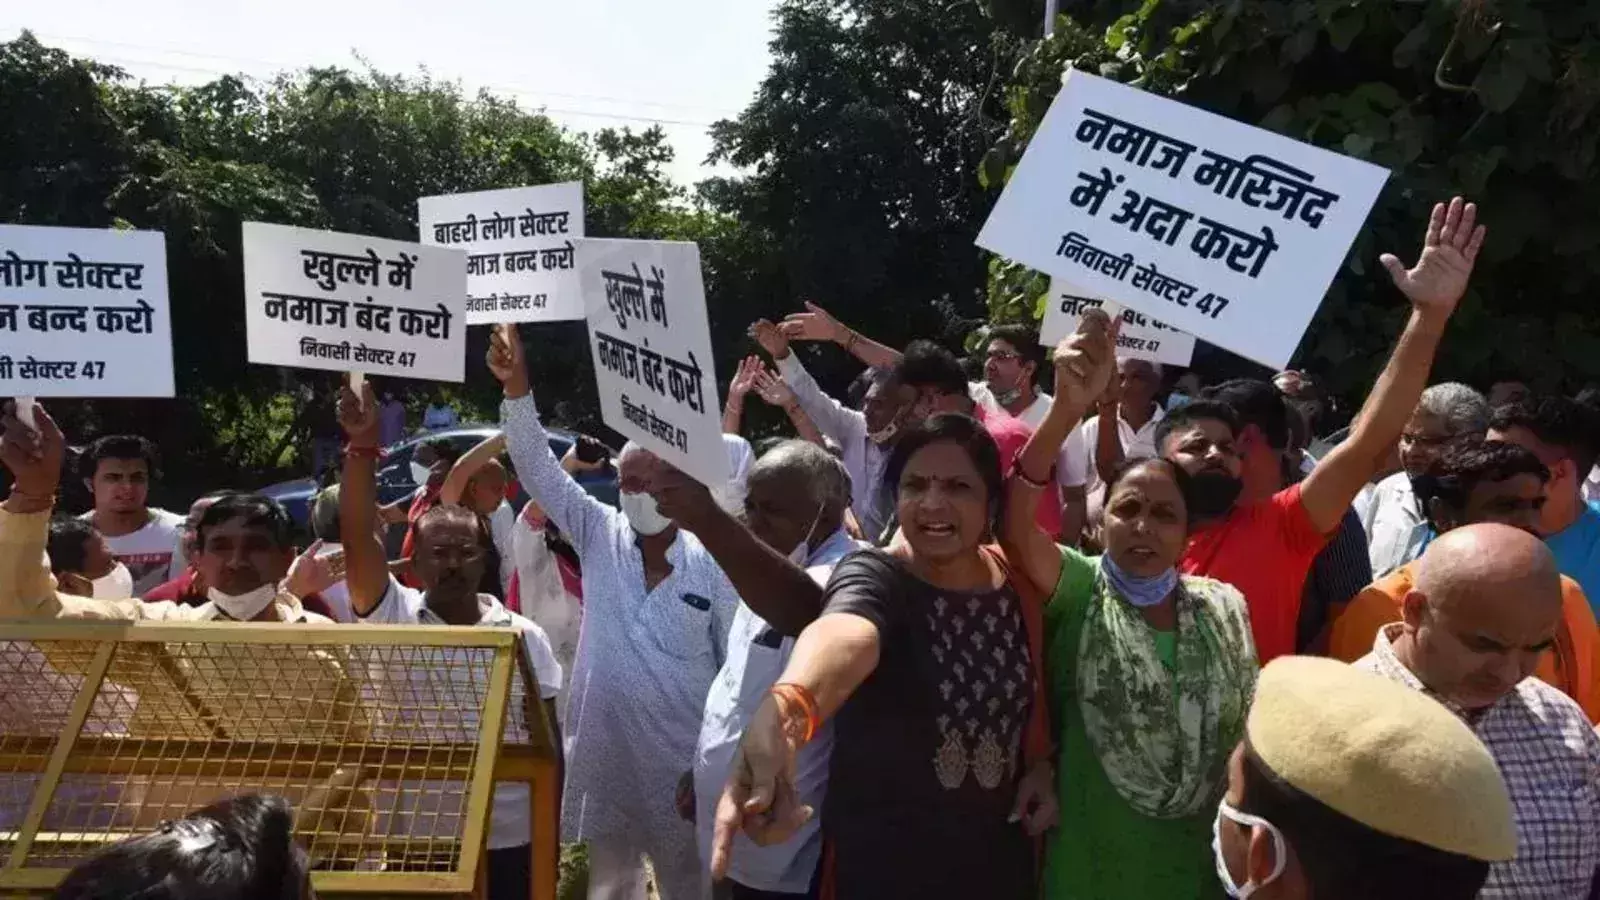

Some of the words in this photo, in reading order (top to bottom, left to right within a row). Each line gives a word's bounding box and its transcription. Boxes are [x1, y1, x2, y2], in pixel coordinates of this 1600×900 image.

[1075, 108, 1198, 178] नमाज
[1193, 154, 1340, 229] मस्जिद
[433, 213, 477, 243] बाहरी
[480, 211, 516, 240] लोग
[518, 208, 569, 237] सेक्टर
[1069, 167, 1125, 216] में
[1110, 190, 1194, 246] अदा
[1190, 226, 1279, 279] करो
[53, 252, 144, 290] सेक्टर
[301, 248, 381, 291] खुल्ले
[386, 252, 418, 290] में
[467, 253, 501, 275] माज
[503, 250, 537, 272] बन्द
[540, 240, 575, 270] करो
[1056, 231, 1135, 281] निवासी
[1131, 263, 1199, 307] सेक्टर
[1195, 293, 1229, 319] 47
[500, 293, 531, 311] सेक्टर
[533, 294, 547, 308] 47
[601, 262, 648, 330] खुल्ले
[645, 265, 668, 328] में
[24, 305, 89, 332] बन्द
[93, 299, 155, 334] करो
[262, 292, 349, 328] नमाज
[353, 296, 393, 333] बंद
[398, 303, 452, 339] करो
[299, 337, 350, 361] निवासी
[353, 343, 395, 366] सेक्टर
[398, 352, 416, 367] 47
[1148, 341, 1160, 352] 47
[17, 355, 77, 379] सेक्टर
[82, 361, 106, 379] 47
[595, 331, 641, 385] नमाज
[639, 338, 665, 396] बंद
[663, 351, 705, 414] करो
[676, 428, 687, 454] 47
